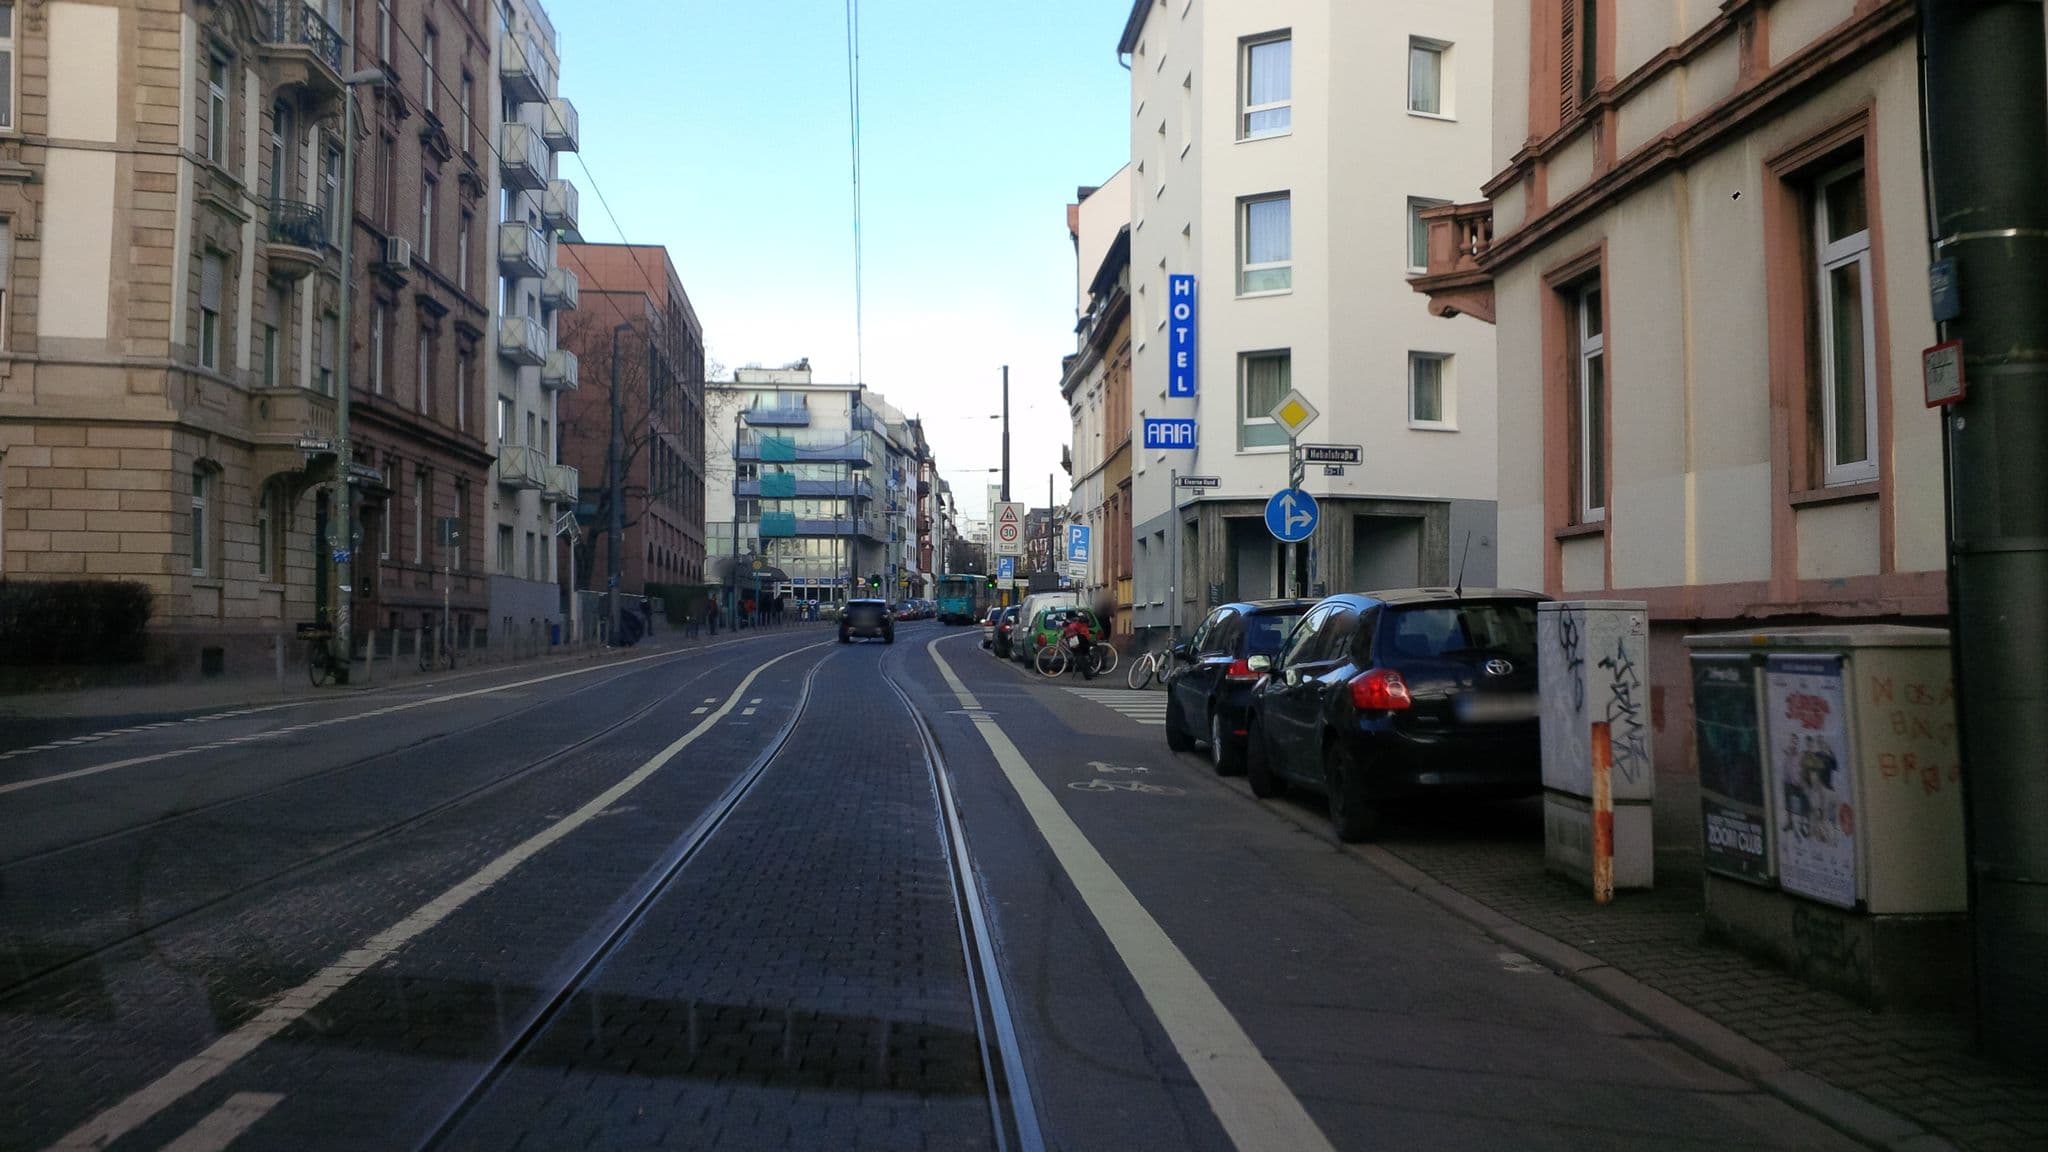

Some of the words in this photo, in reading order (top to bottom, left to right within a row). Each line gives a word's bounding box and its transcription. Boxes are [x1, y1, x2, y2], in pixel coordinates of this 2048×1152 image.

[1174, 279, 1190, 392] HOTEL
[1147, 423, 1191, 444] ARIA
[1310, 449, 1354, 460] Hebelstraße
[1004, 528, 1013, 537] 30
[1072, 529, 1082, 544] P
[1000, 558, 1007, 568] P
